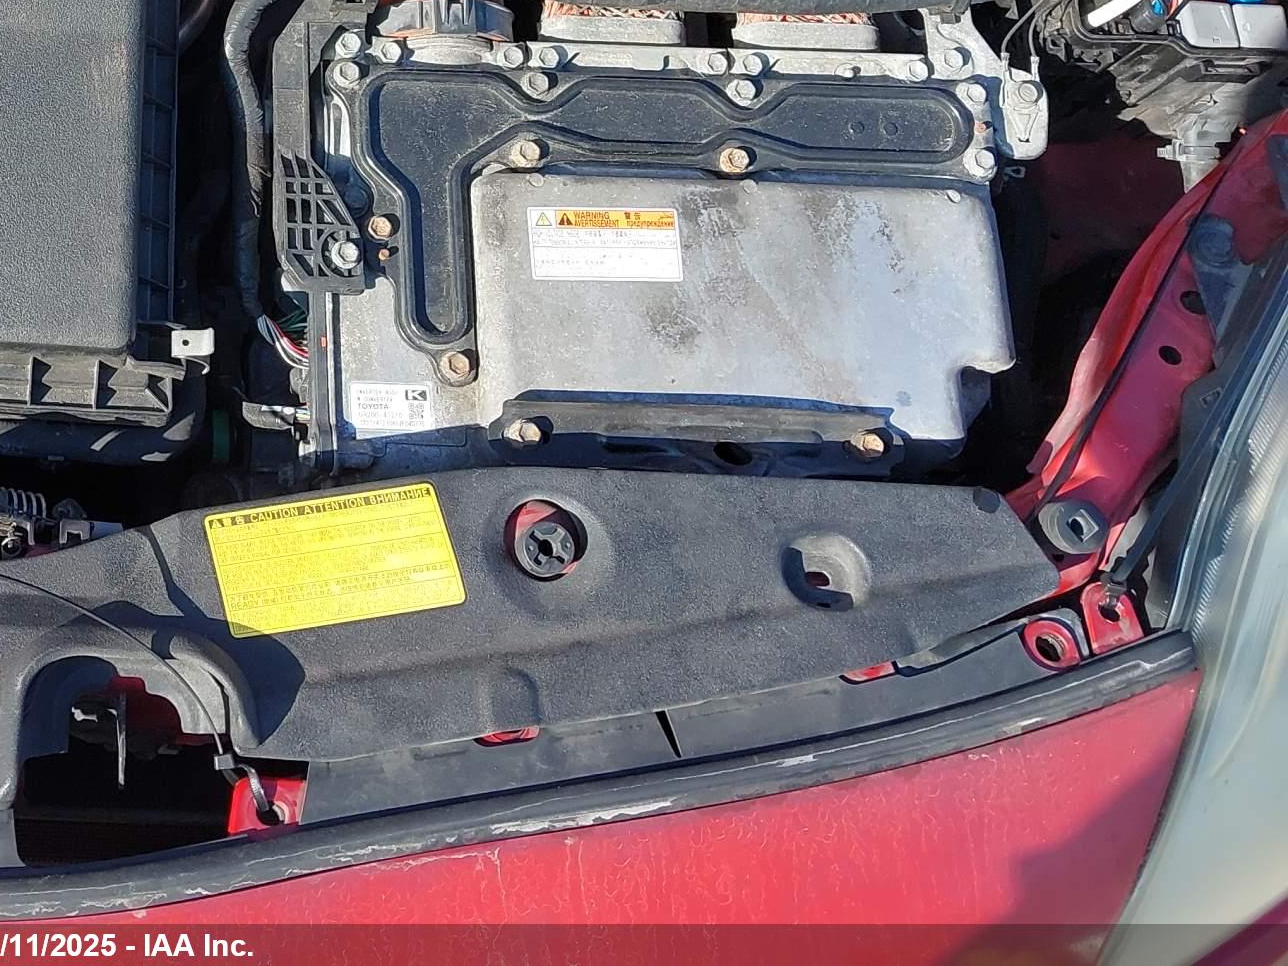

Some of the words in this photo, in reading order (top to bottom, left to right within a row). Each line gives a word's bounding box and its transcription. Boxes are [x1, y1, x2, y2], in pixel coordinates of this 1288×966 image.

[573, 211, 610, 220] WARNING
[574, 219, 620, 228] AVERTISSEMENT
[250, 507, 299, 523] CAUTION
[304, 497, 366, 514] ATTENTION
[370, 487, 430, 506] ВНИМАНИЕ
